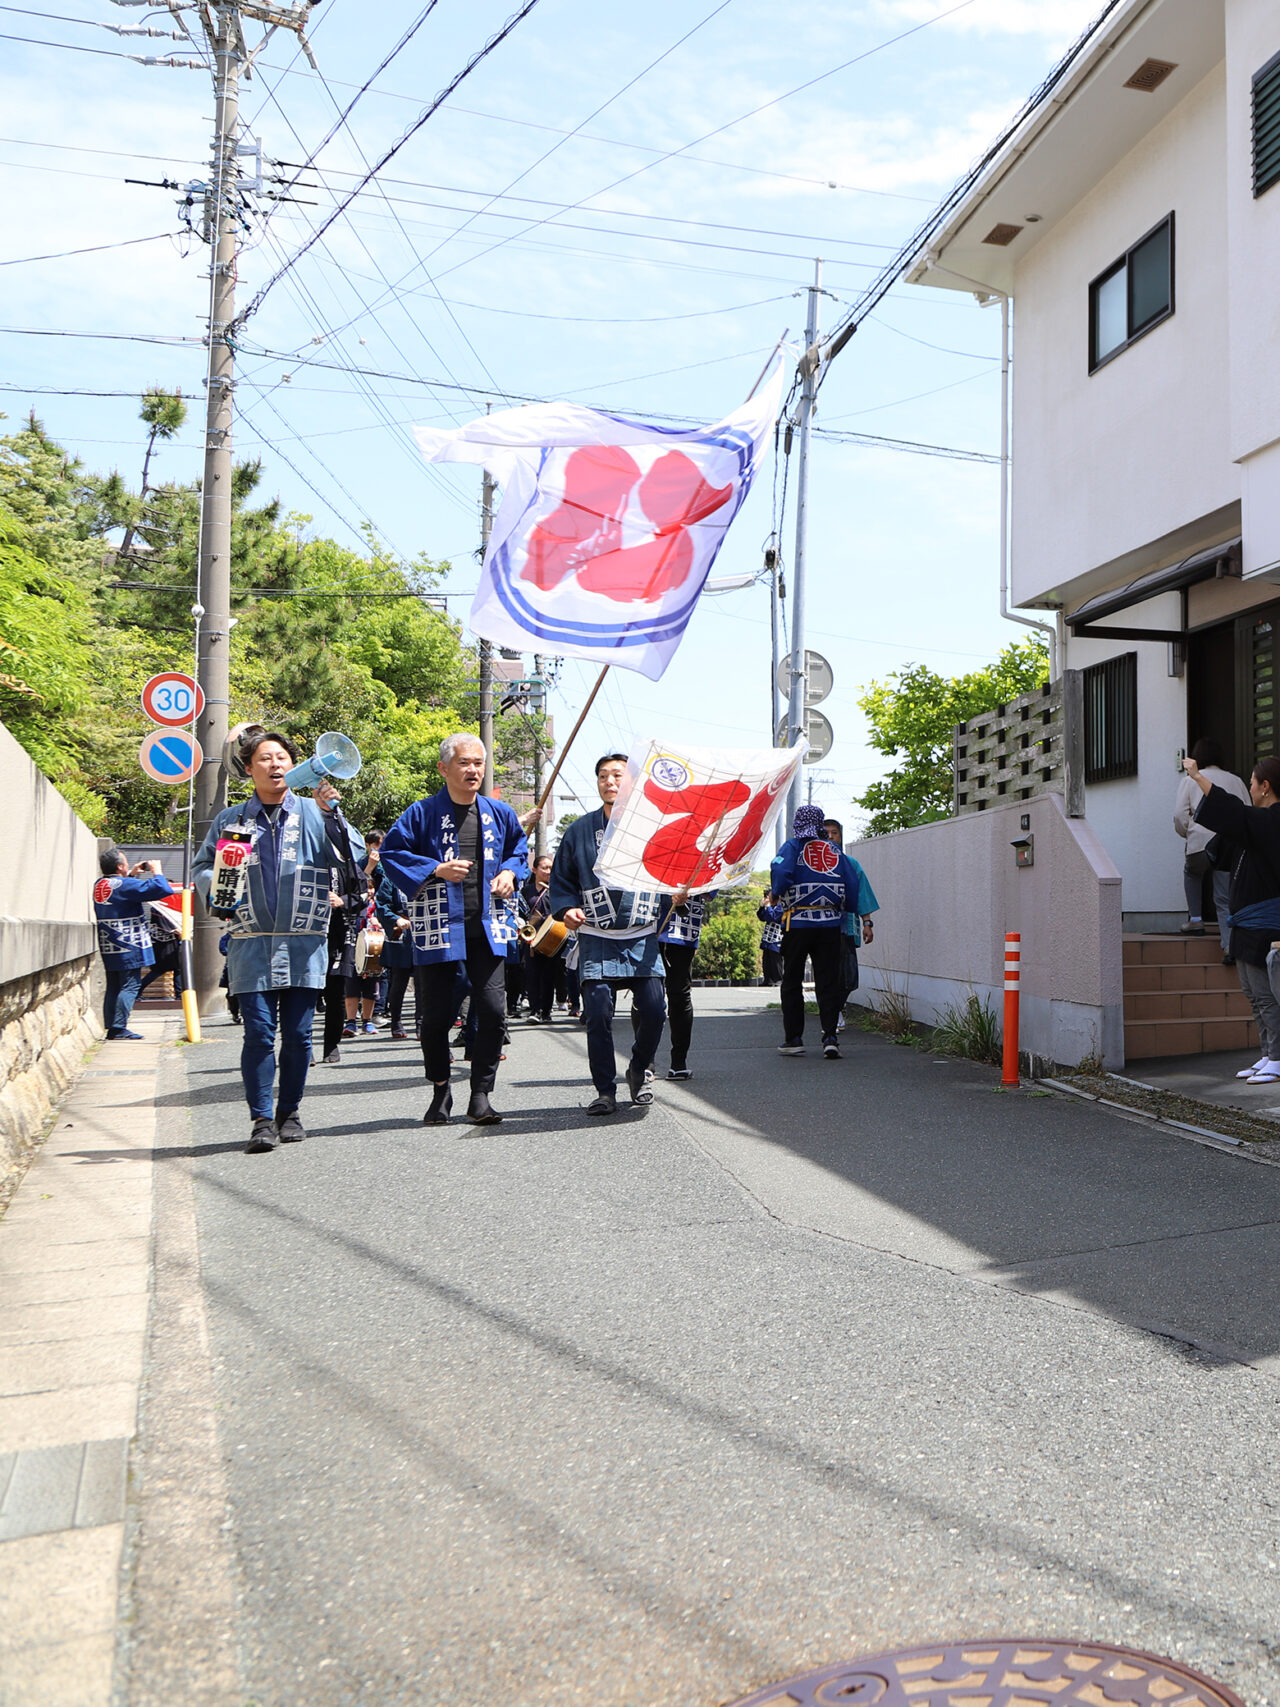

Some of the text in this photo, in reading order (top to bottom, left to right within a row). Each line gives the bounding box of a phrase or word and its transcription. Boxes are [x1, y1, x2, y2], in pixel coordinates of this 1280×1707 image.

[157, 688, 190, 712] 30
[481, 813, 495, 861] ひろ組
